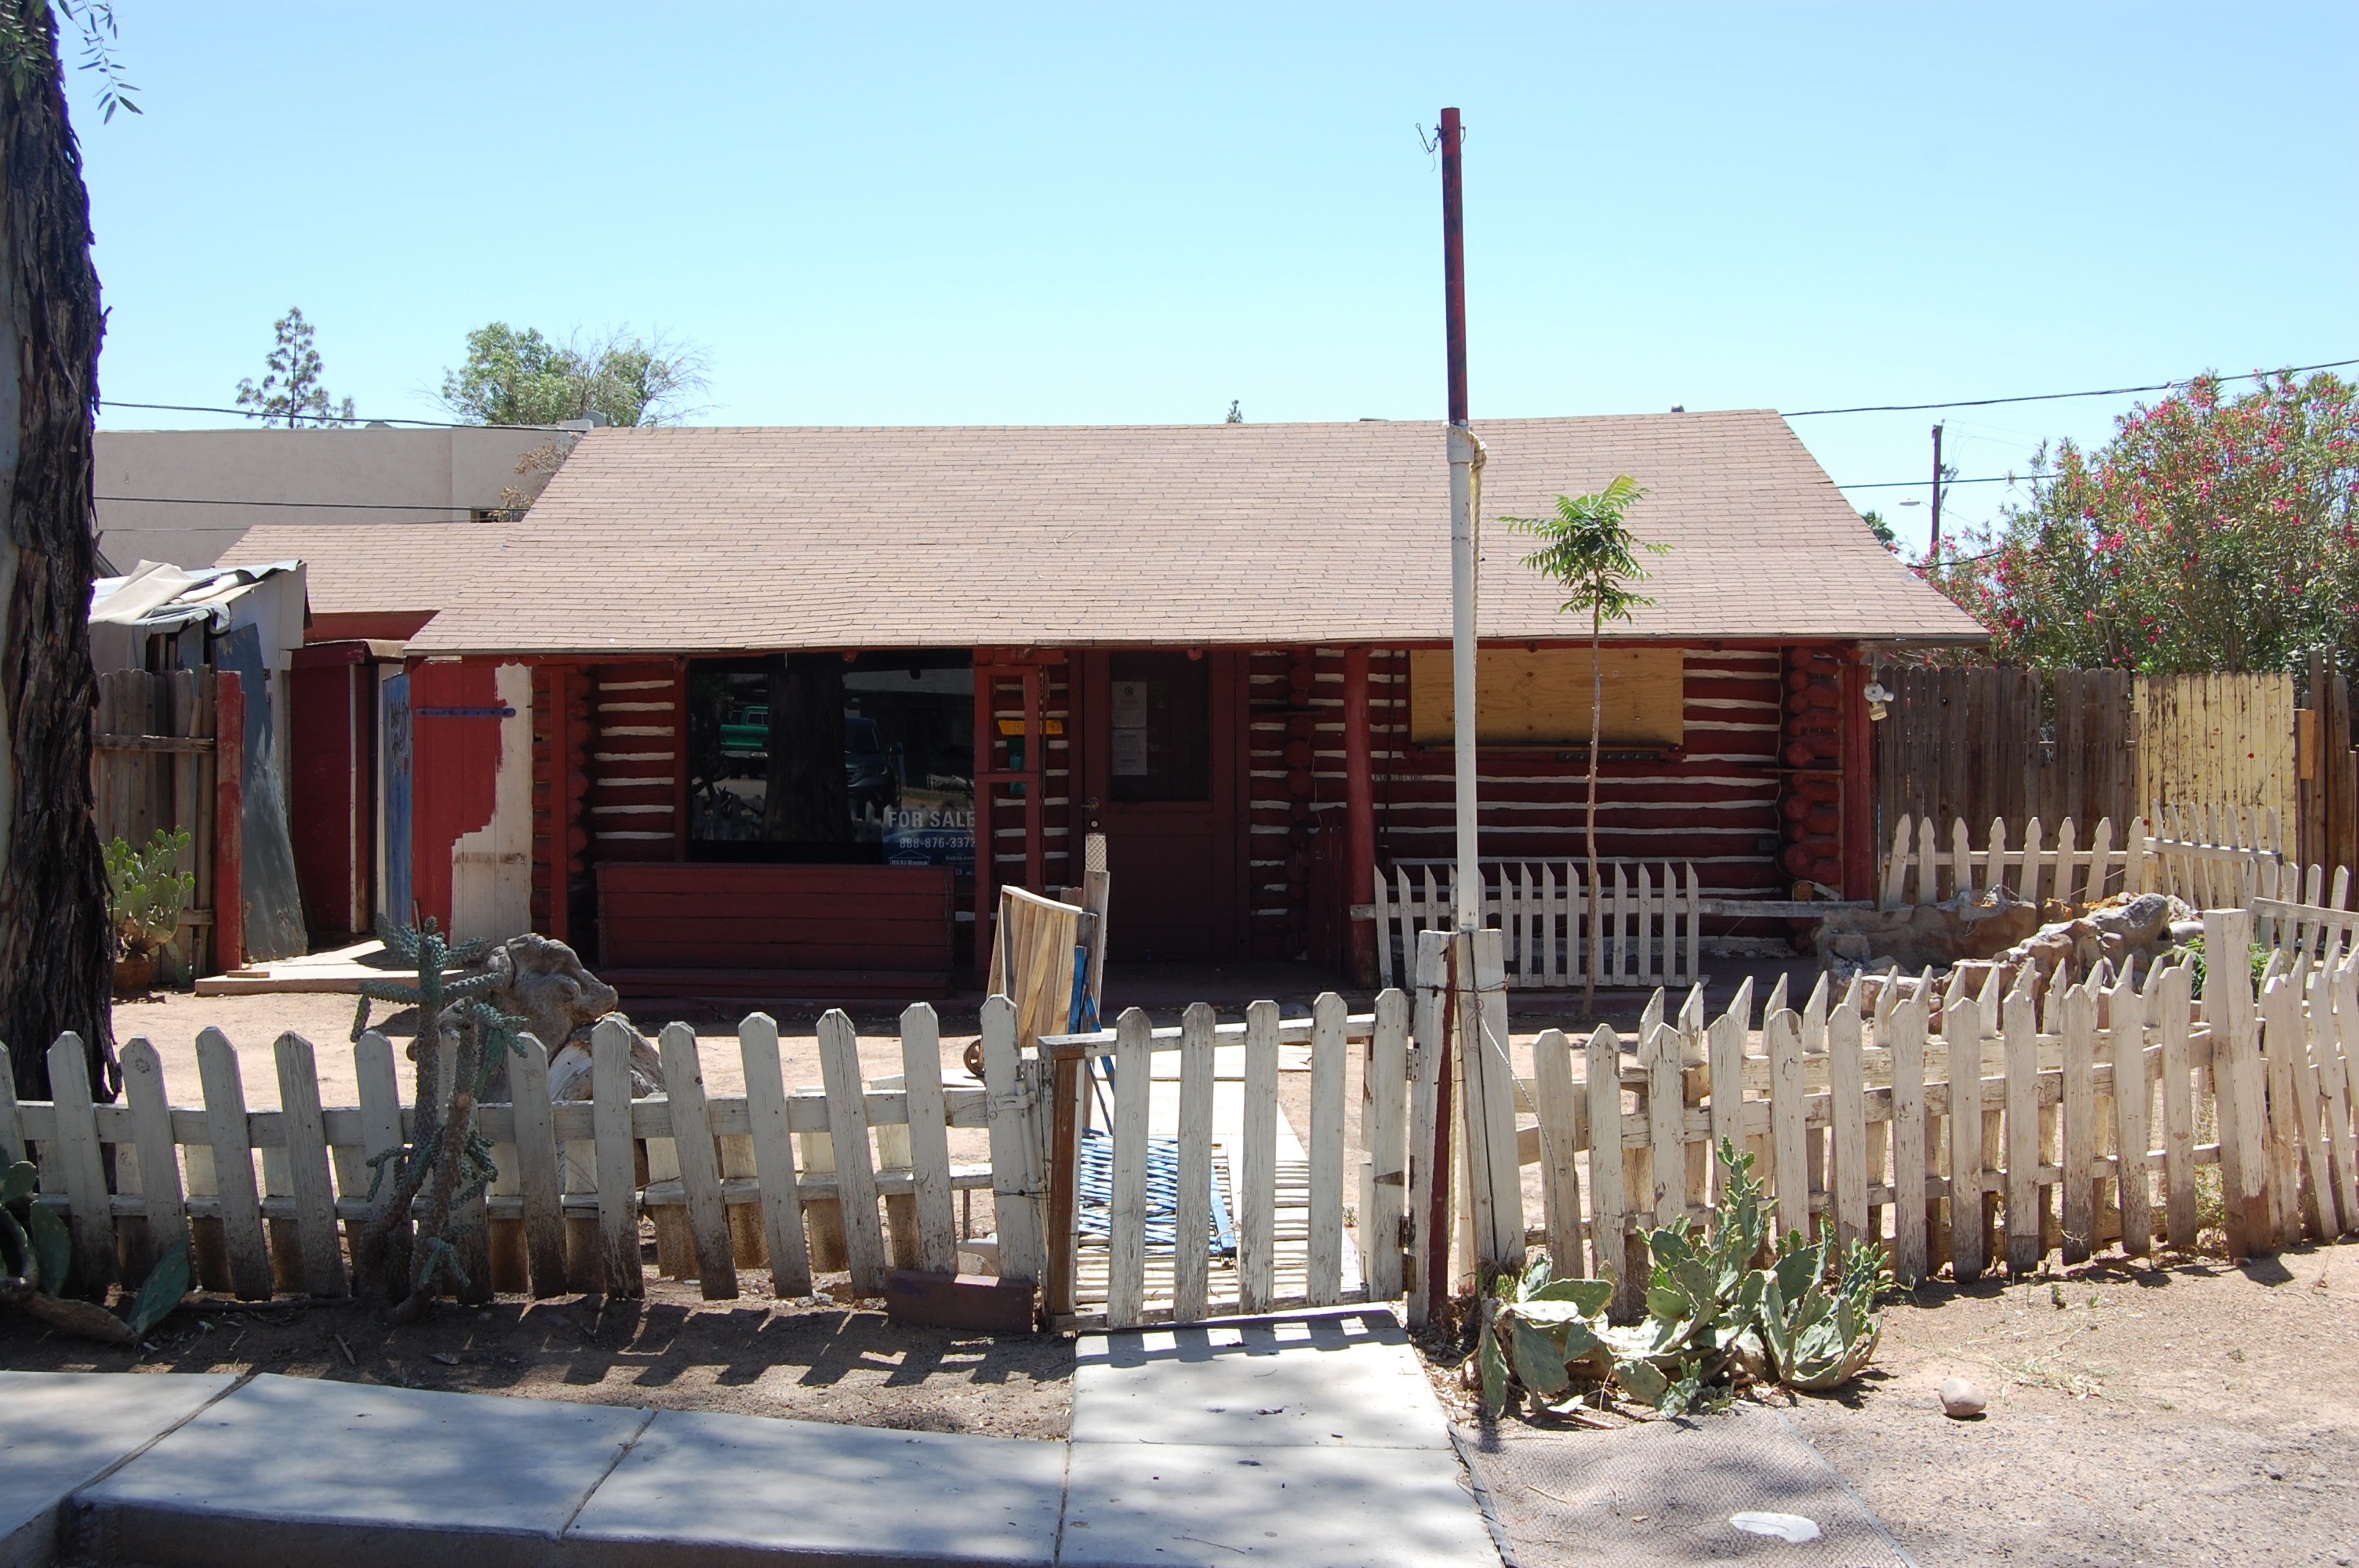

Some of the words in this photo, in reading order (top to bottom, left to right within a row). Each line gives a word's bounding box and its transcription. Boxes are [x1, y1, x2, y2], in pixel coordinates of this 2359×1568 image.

[888, 811, 923, 828] FOR
[929, 811, 976, 828] SALE
[899, 837, 976, 848] 888-876-3372
